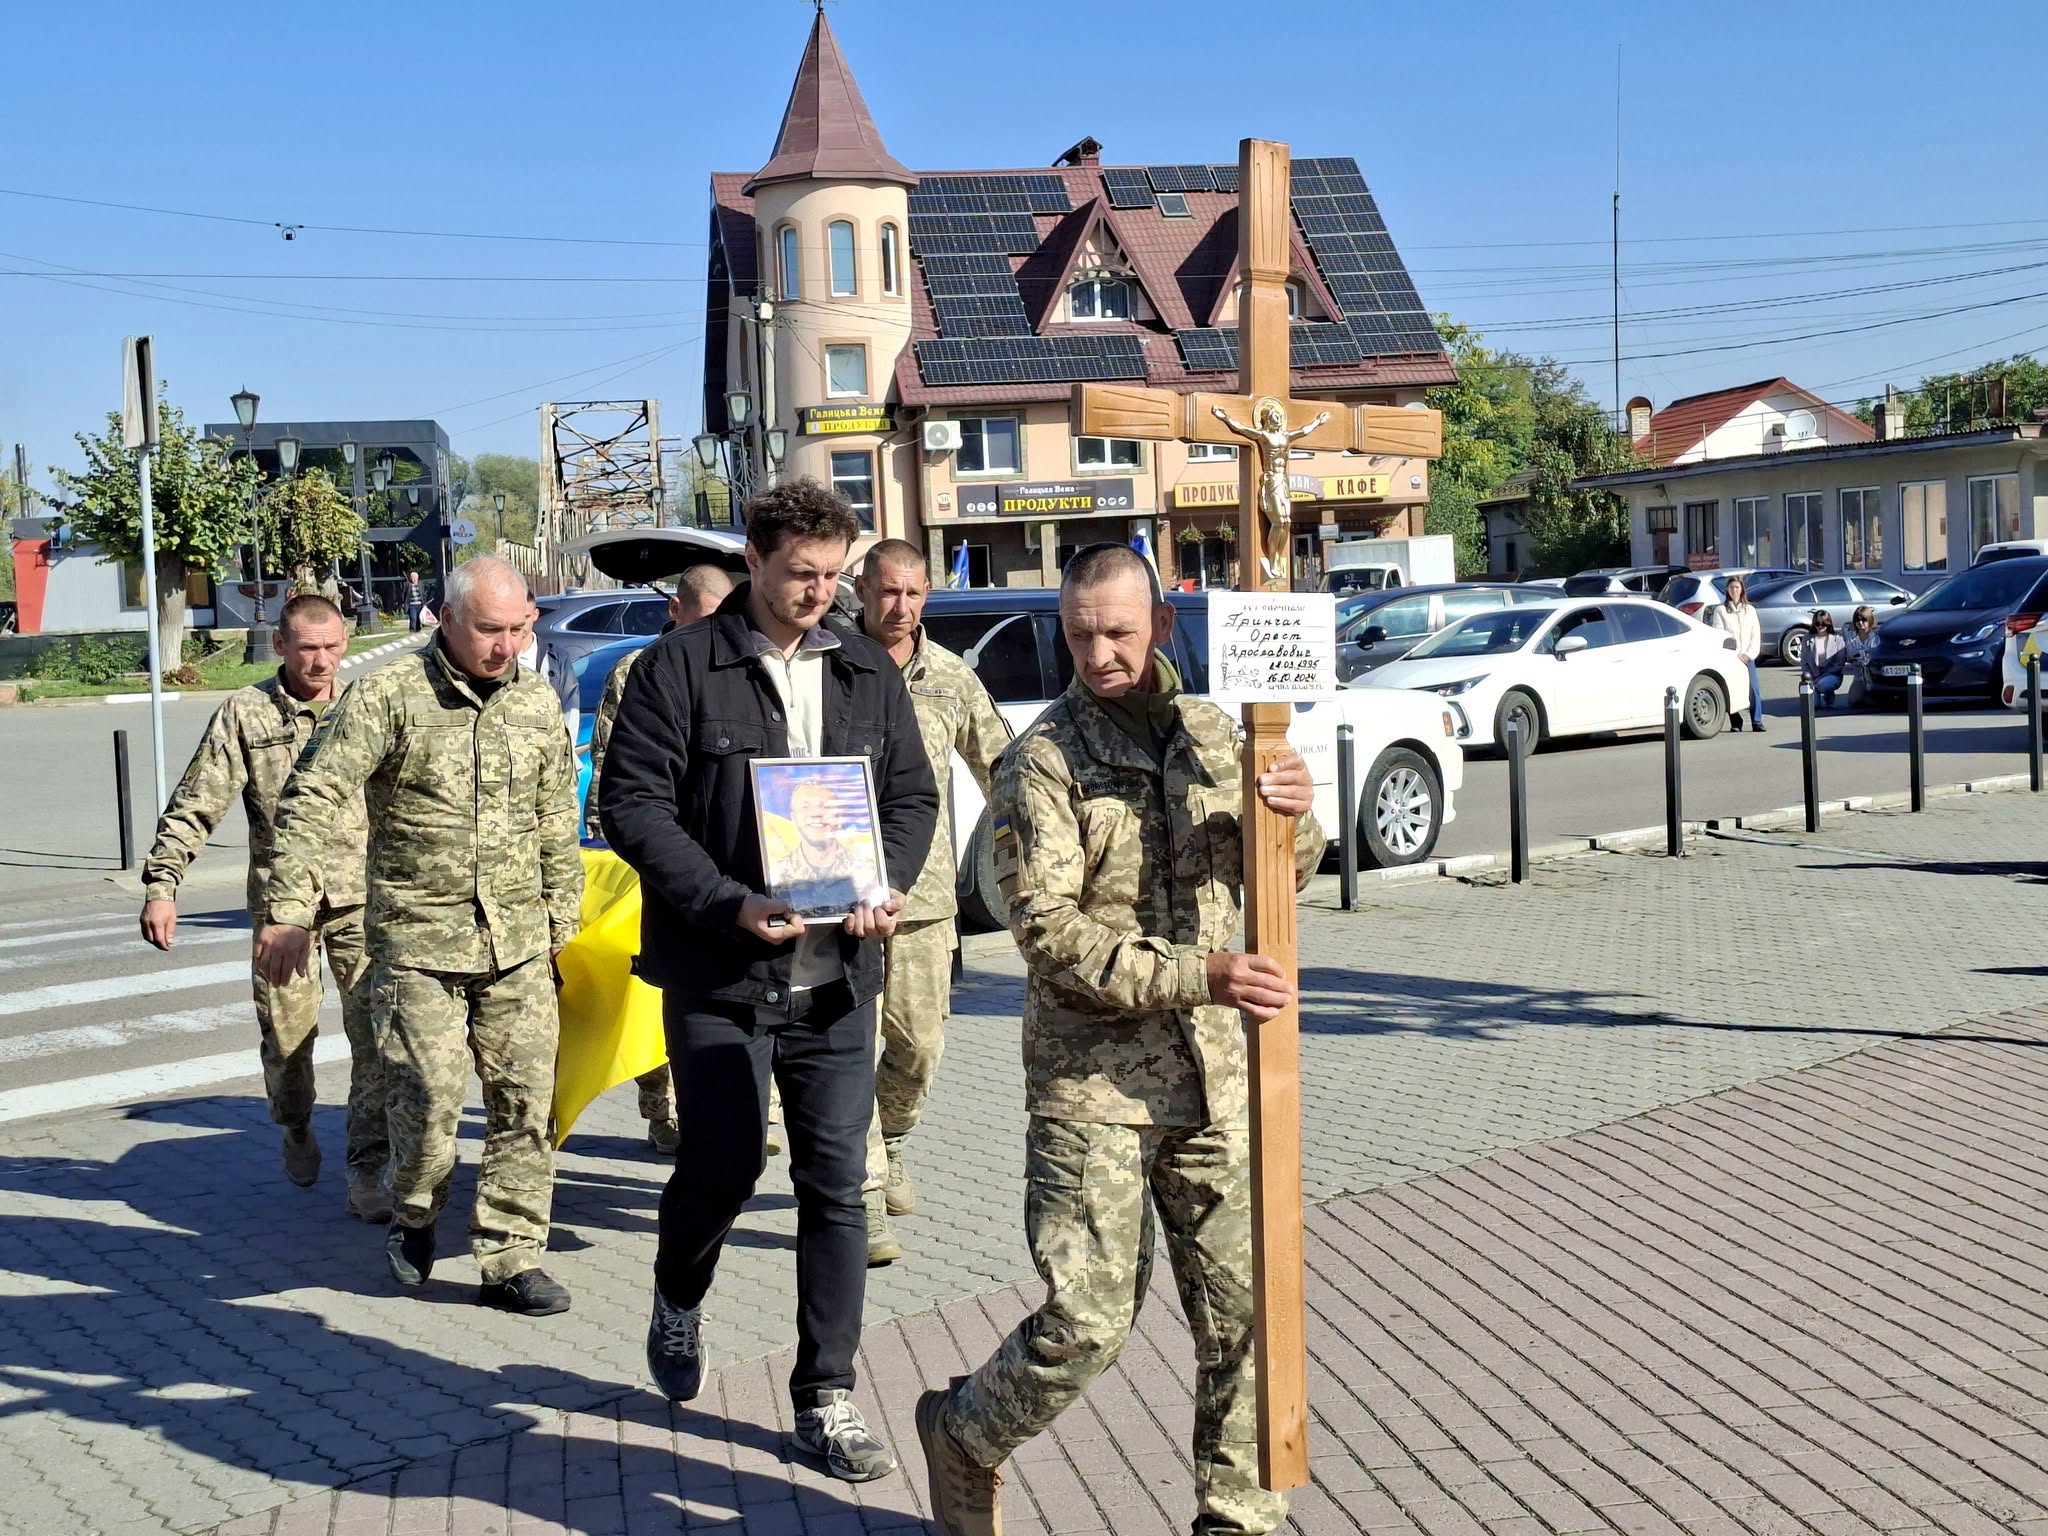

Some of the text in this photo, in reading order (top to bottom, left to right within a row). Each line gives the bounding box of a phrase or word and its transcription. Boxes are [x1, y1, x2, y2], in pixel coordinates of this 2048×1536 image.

[810, 408, 857, 418] Галицька
[824, 420, 886, 431] ПРОДУКТИ
[1337, 478, 1377, 495] КАФЕ
[1003, 496, 1093, 512] ПРОДУКТИ
[1250, 628, 1302, 647] Орест
